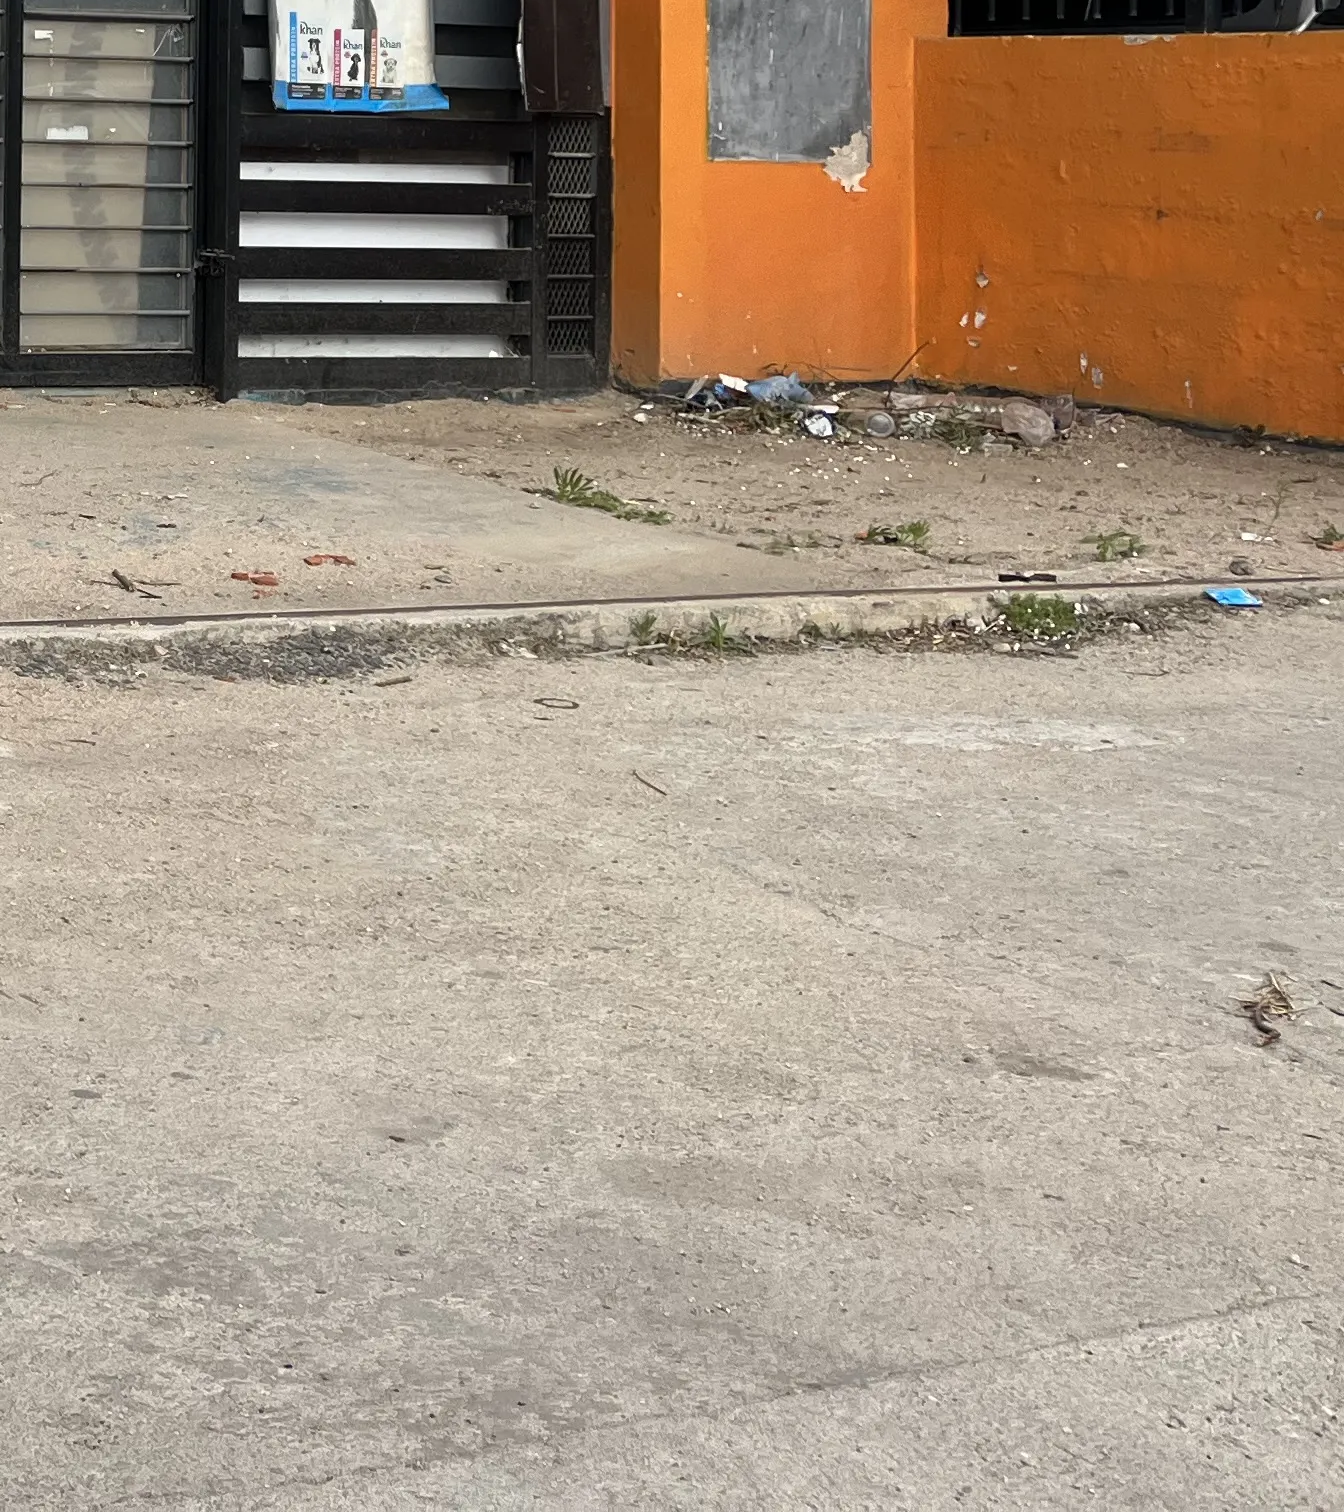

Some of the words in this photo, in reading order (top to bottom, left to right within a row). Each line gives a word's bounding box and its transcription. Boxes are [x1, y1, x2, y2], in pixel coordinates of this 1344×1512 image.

[299, 21, 323, 35] khan
[343, 39, 363, 50] khan
[379, 37, 402, 48] khan
